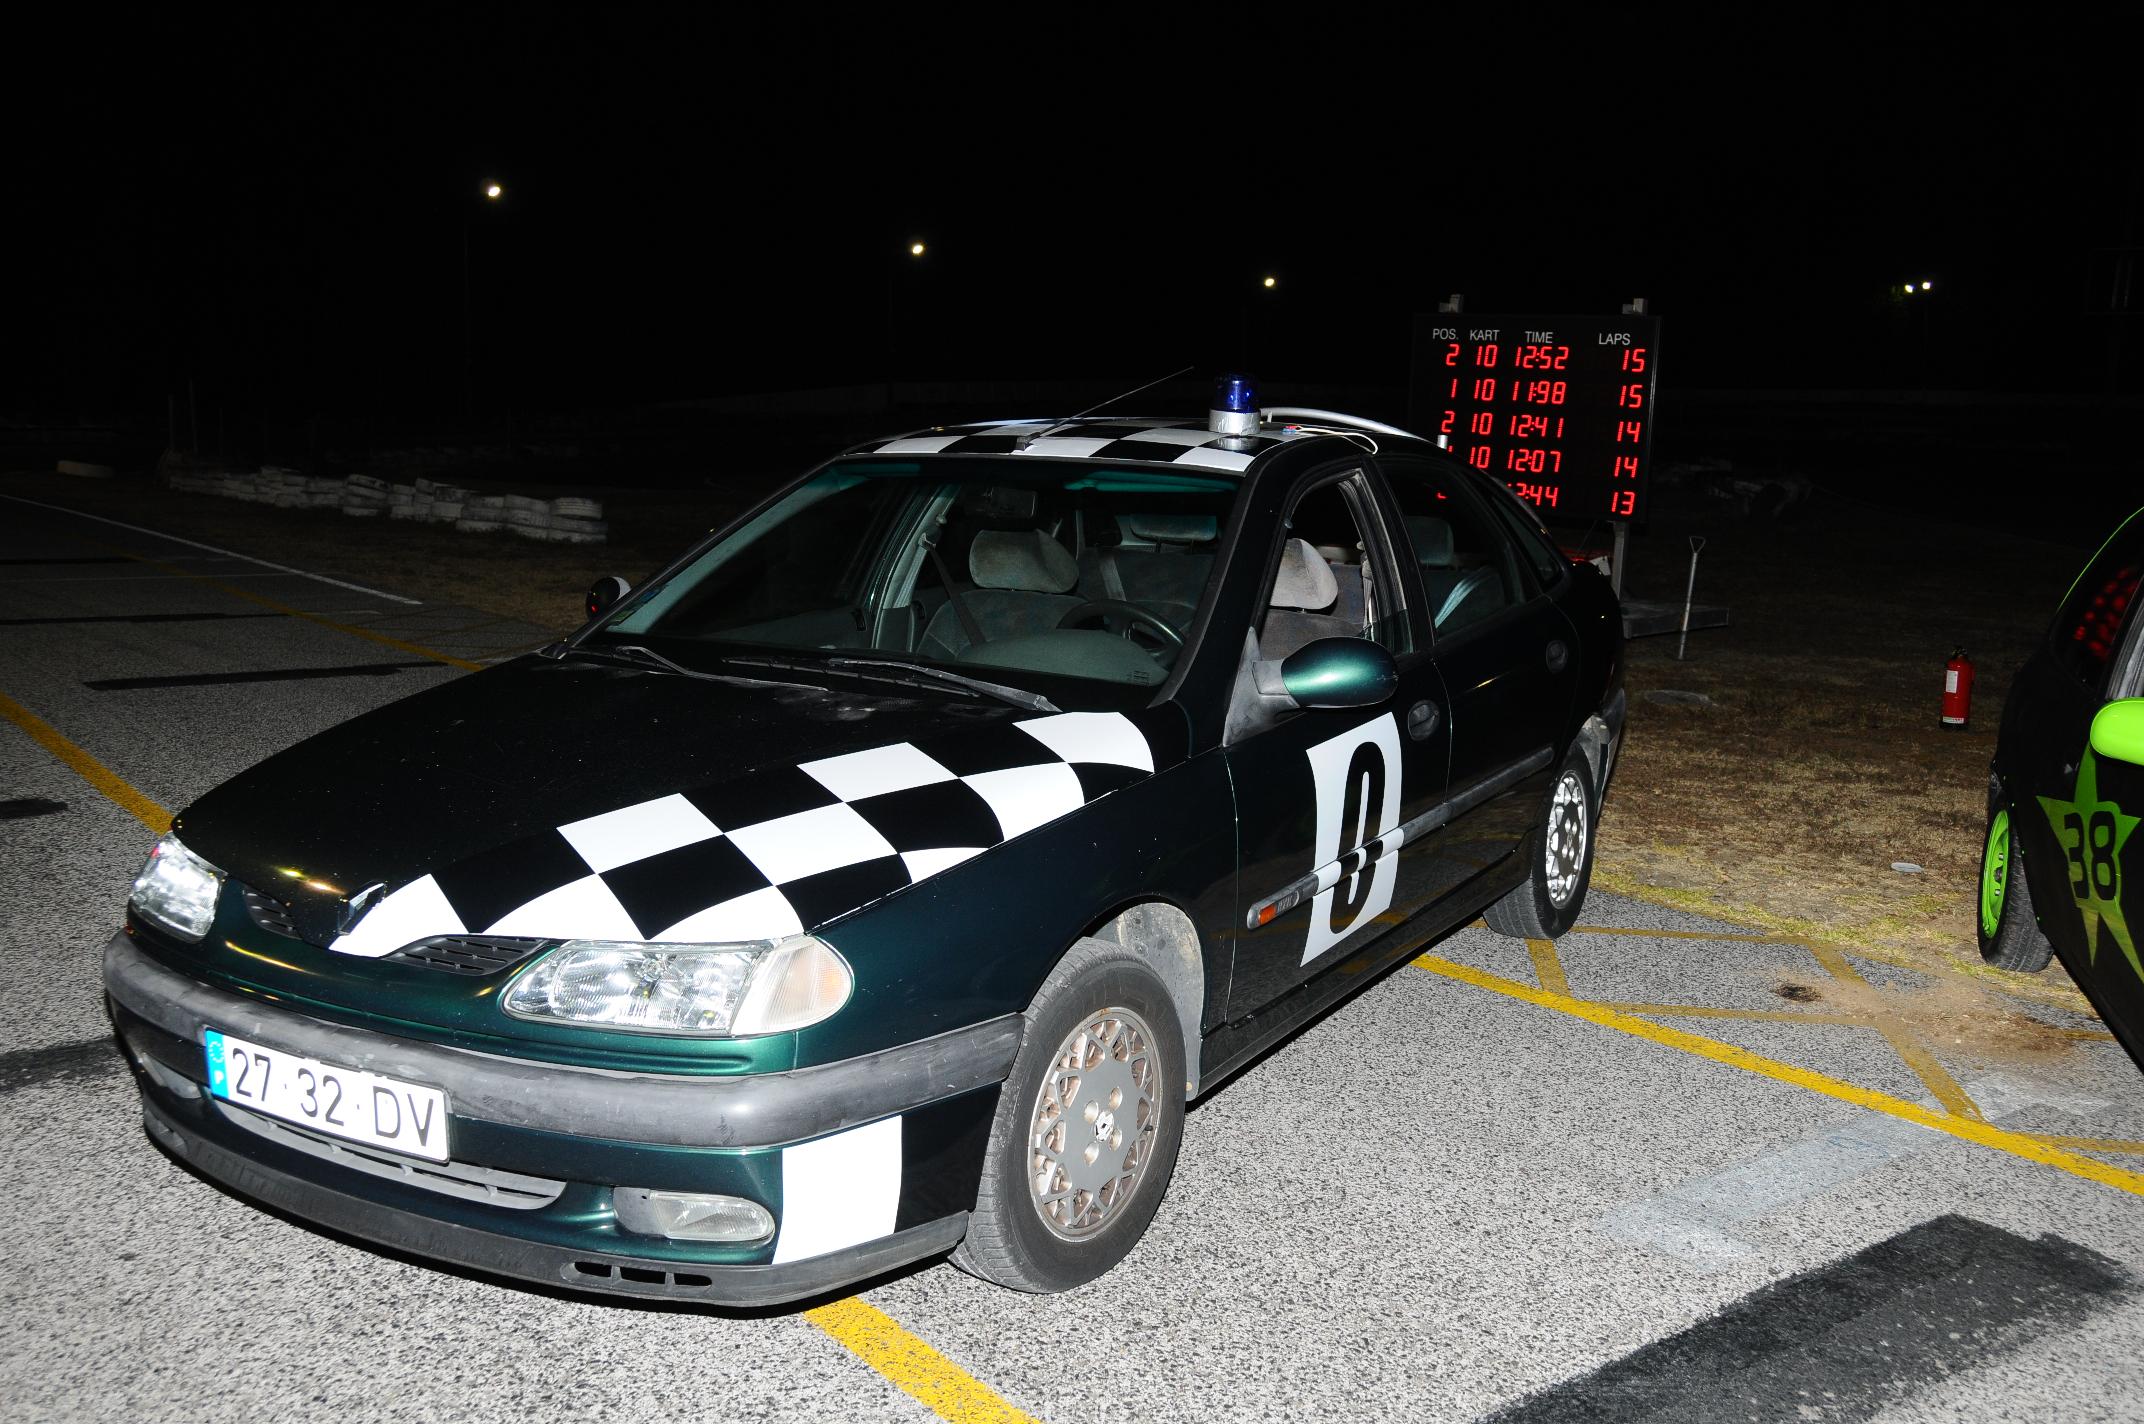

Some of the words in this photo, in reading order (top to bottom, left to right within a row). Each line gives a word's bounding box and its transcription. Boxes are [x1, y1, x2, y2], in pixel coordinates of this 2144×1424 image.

[1469, 329, 1500, 342] KART
[1525, 331, 1553, 344] TIME
[1598, 333, 1631, 346] LAPS
[1445, 344, 1460, 367] 2
[1476, 344, 1498, 368] 10
[1515, 346, 1570, 370] 12:52
[1622, 348, 1646, 373] 15
[1450, 378, 1458, 399] 1
[1473, 378, 1496, 401] 10
[1619, 384, 1643, 409] 15
[1441, 410, 1456, 433] 2
[1471, 412, 1494, 436] 10
[1509, 414, 1565, 439] 12:41
[1616, 420, 1641, 444] 14
[1469, 445, 1491, 469] 10
[1507, 448, 1562, 473] 12:07
[1613, 456, 1639, 479] 14
[1611, 490, 1636, 516] 13
[1329, 741, 1386, 934] 0
[2064, 809, 2117, 900] 38
[213, 1070, 225, 1085] P
